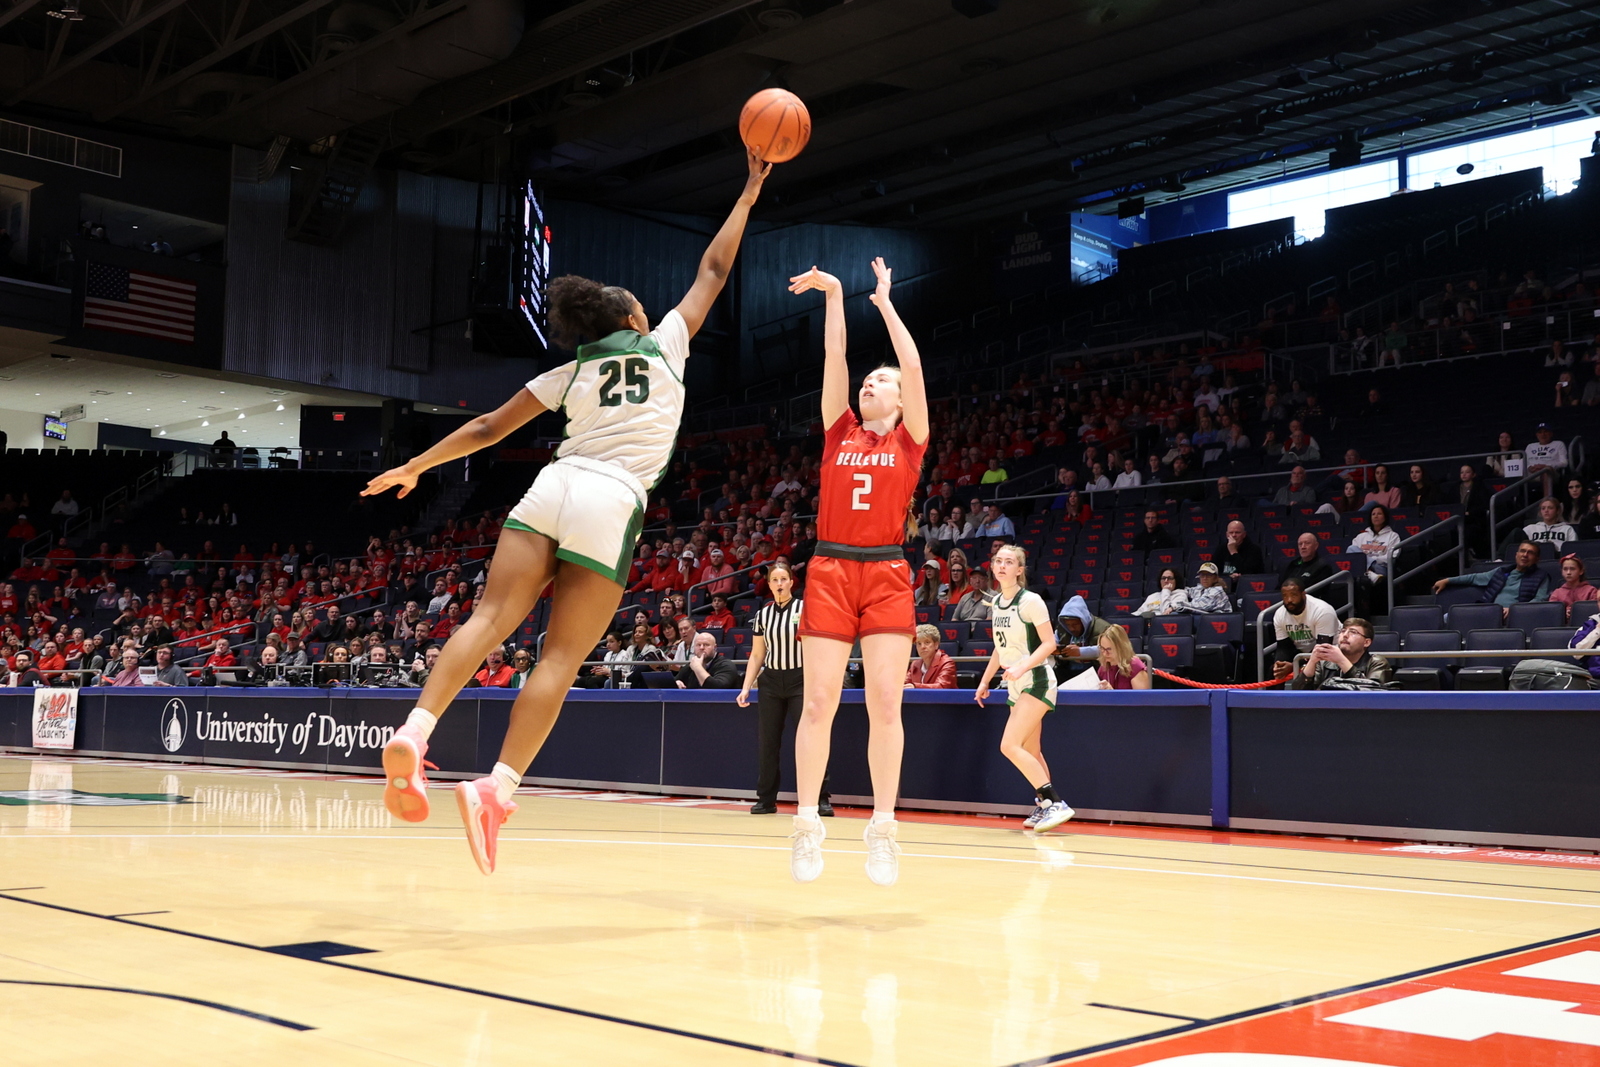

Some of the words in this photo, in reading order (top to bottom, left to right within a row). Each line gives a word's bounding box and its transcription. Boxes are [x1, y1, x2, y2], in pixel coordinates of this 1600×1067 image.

[1014, 231, 1039, 245] BUD
[1010, 239, 1043, 255] LIGHT
[1002, 251, 1052, 270] LANDING
[598, 357, 650, 407] 25
[1531, 446, 1556, 455] DUKE
[835, 452, 896, 467] BELLEVUE
[851, 473, 873, 511] 2
[1532, 530, 1566, 542] OHIO
[195, 710, 289, 754] University
[292, 711, 317, 755] of
[317, 714, 395, 758] Dayton
